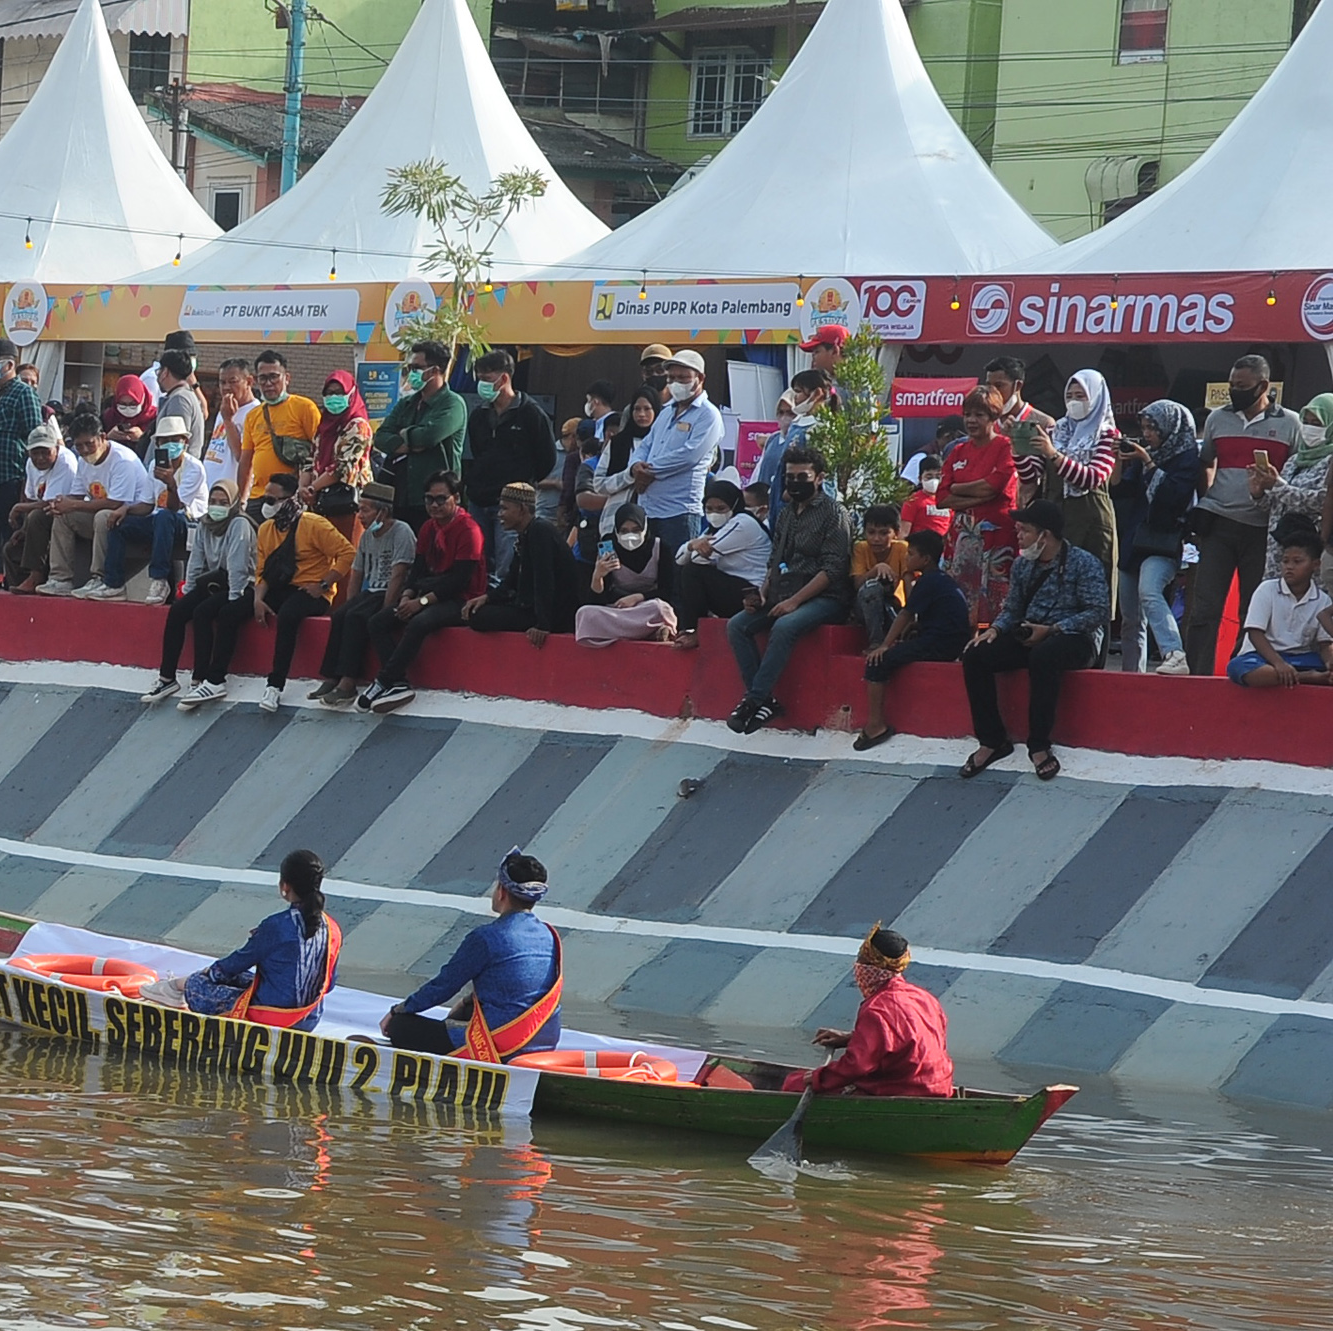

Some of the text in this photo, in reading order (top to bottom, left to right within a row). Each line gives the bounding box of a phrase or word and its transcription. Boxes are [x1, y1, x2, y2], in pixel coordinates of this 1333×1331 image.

[223, 305, 236, 317] PT
[238, 305, 272, 317] BUKIT
[272, 305, 305, 317] ASAM
[307, 304, 328, 317] TBK
[616, 300, 792, 317] Dinas PUPR Kota Palembang
[1016, 283, 1234, 334] sinarmas
[895, 388, 964, 406] smartfren
[103, 997, 271, 1075] SEBERANG
